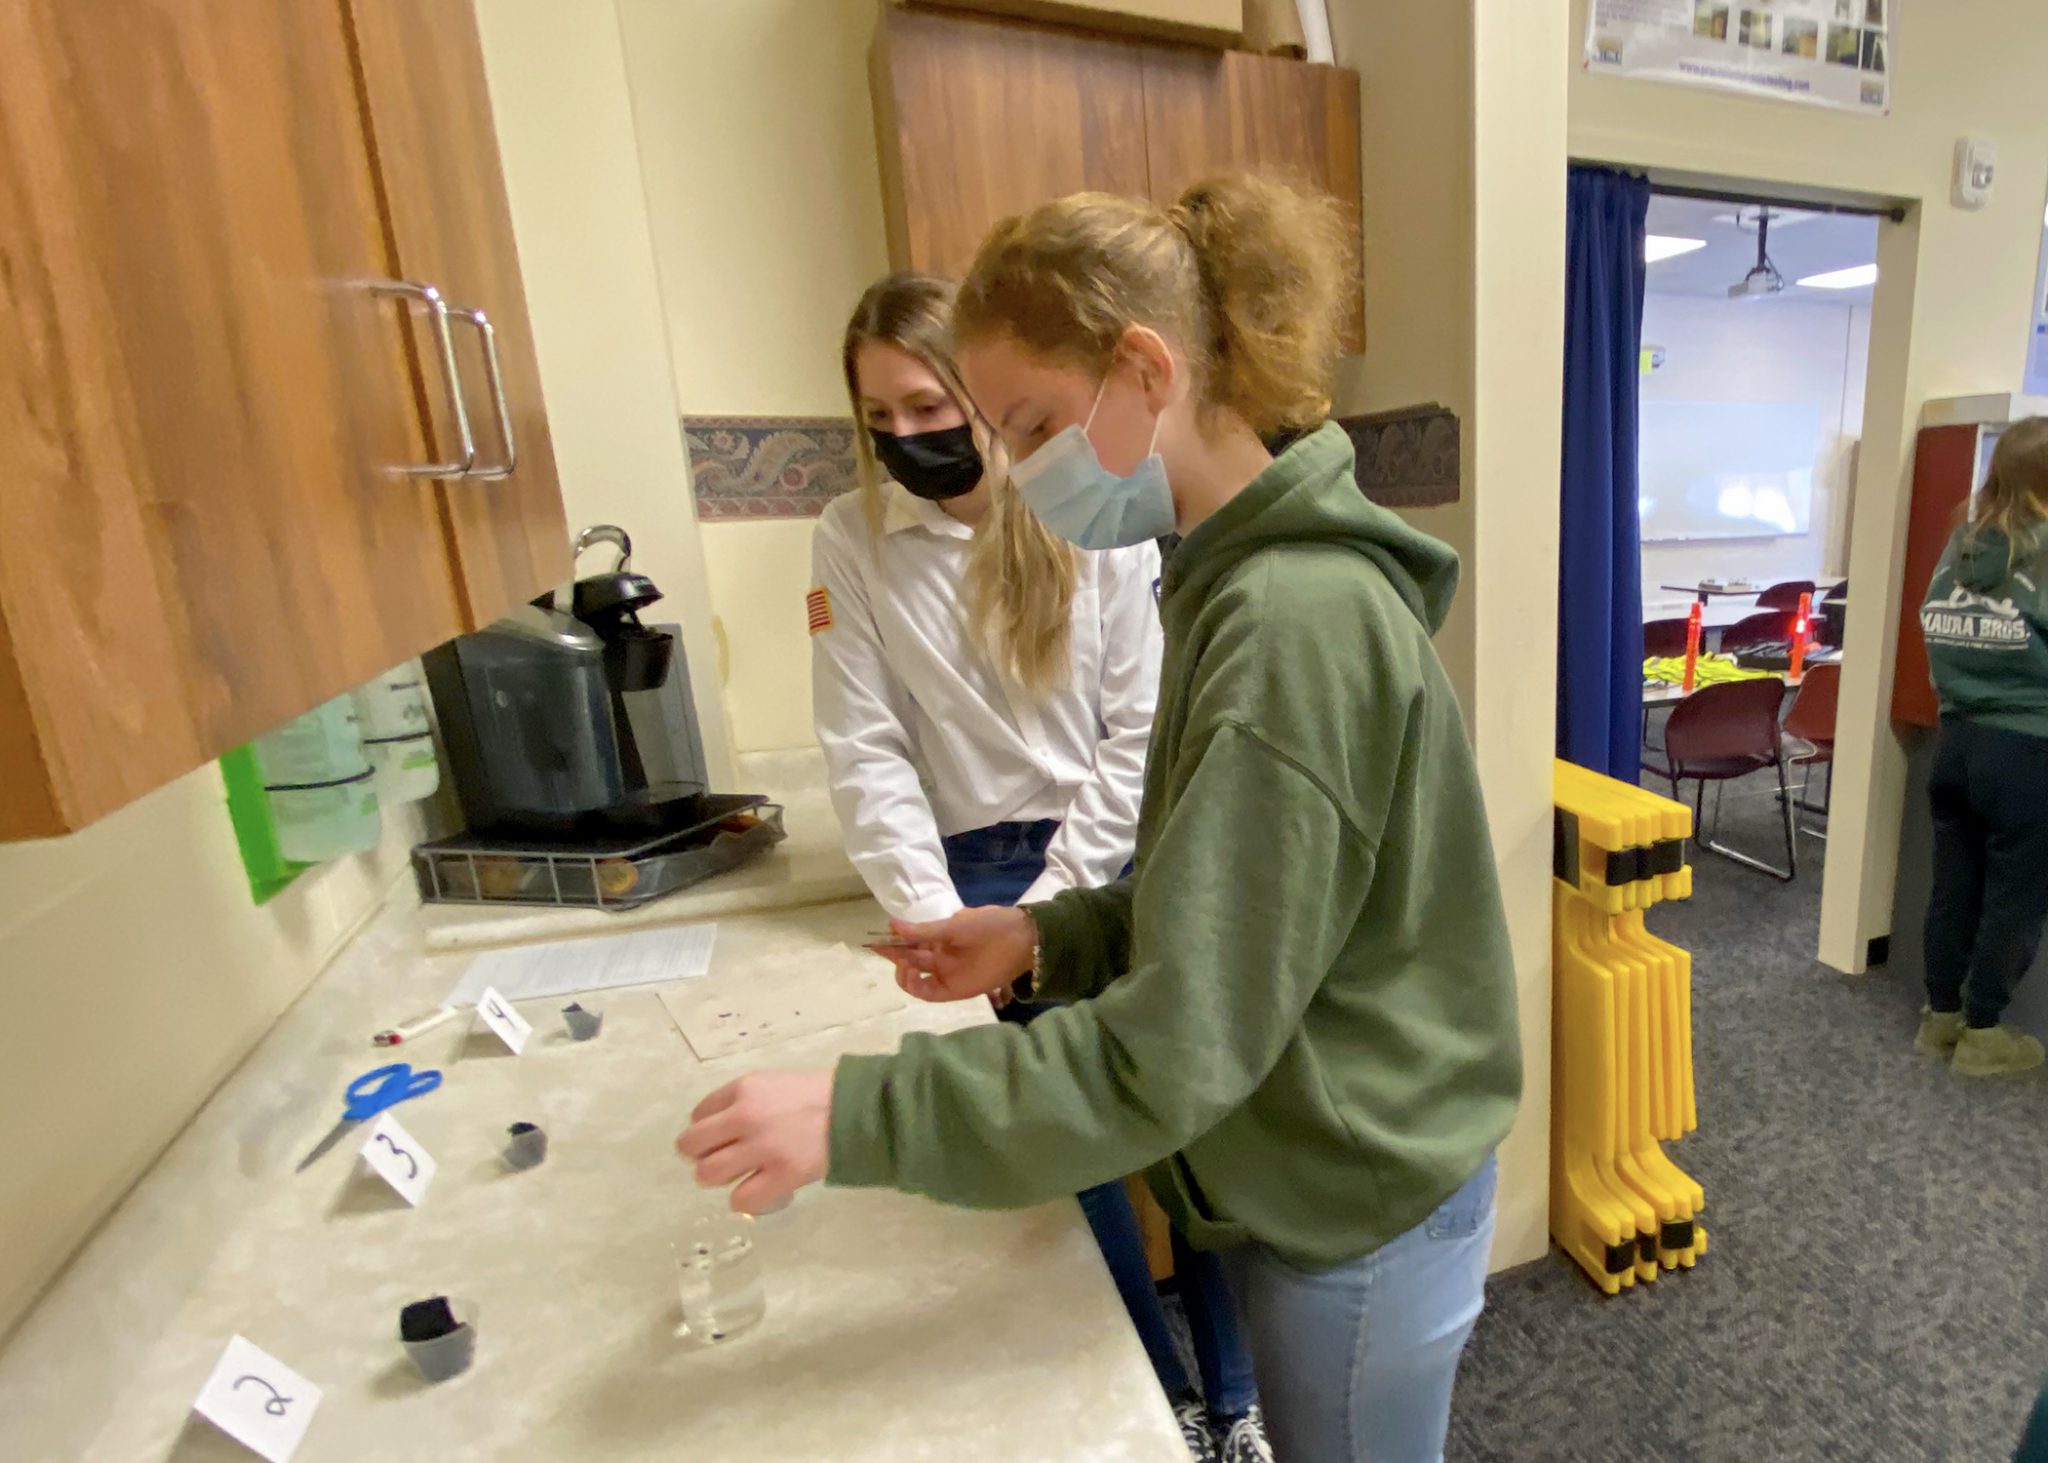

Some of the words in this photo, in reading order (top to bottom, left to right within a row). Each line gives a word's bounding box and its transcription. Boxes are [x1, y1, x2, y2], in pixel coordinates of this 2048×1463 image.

[1979, 617, 2026, 639] BROS
[488, 999, 518, 1030] 4
[376, 1133, 418, 1179] 3
[233, 1375, 294, 1416] 2
